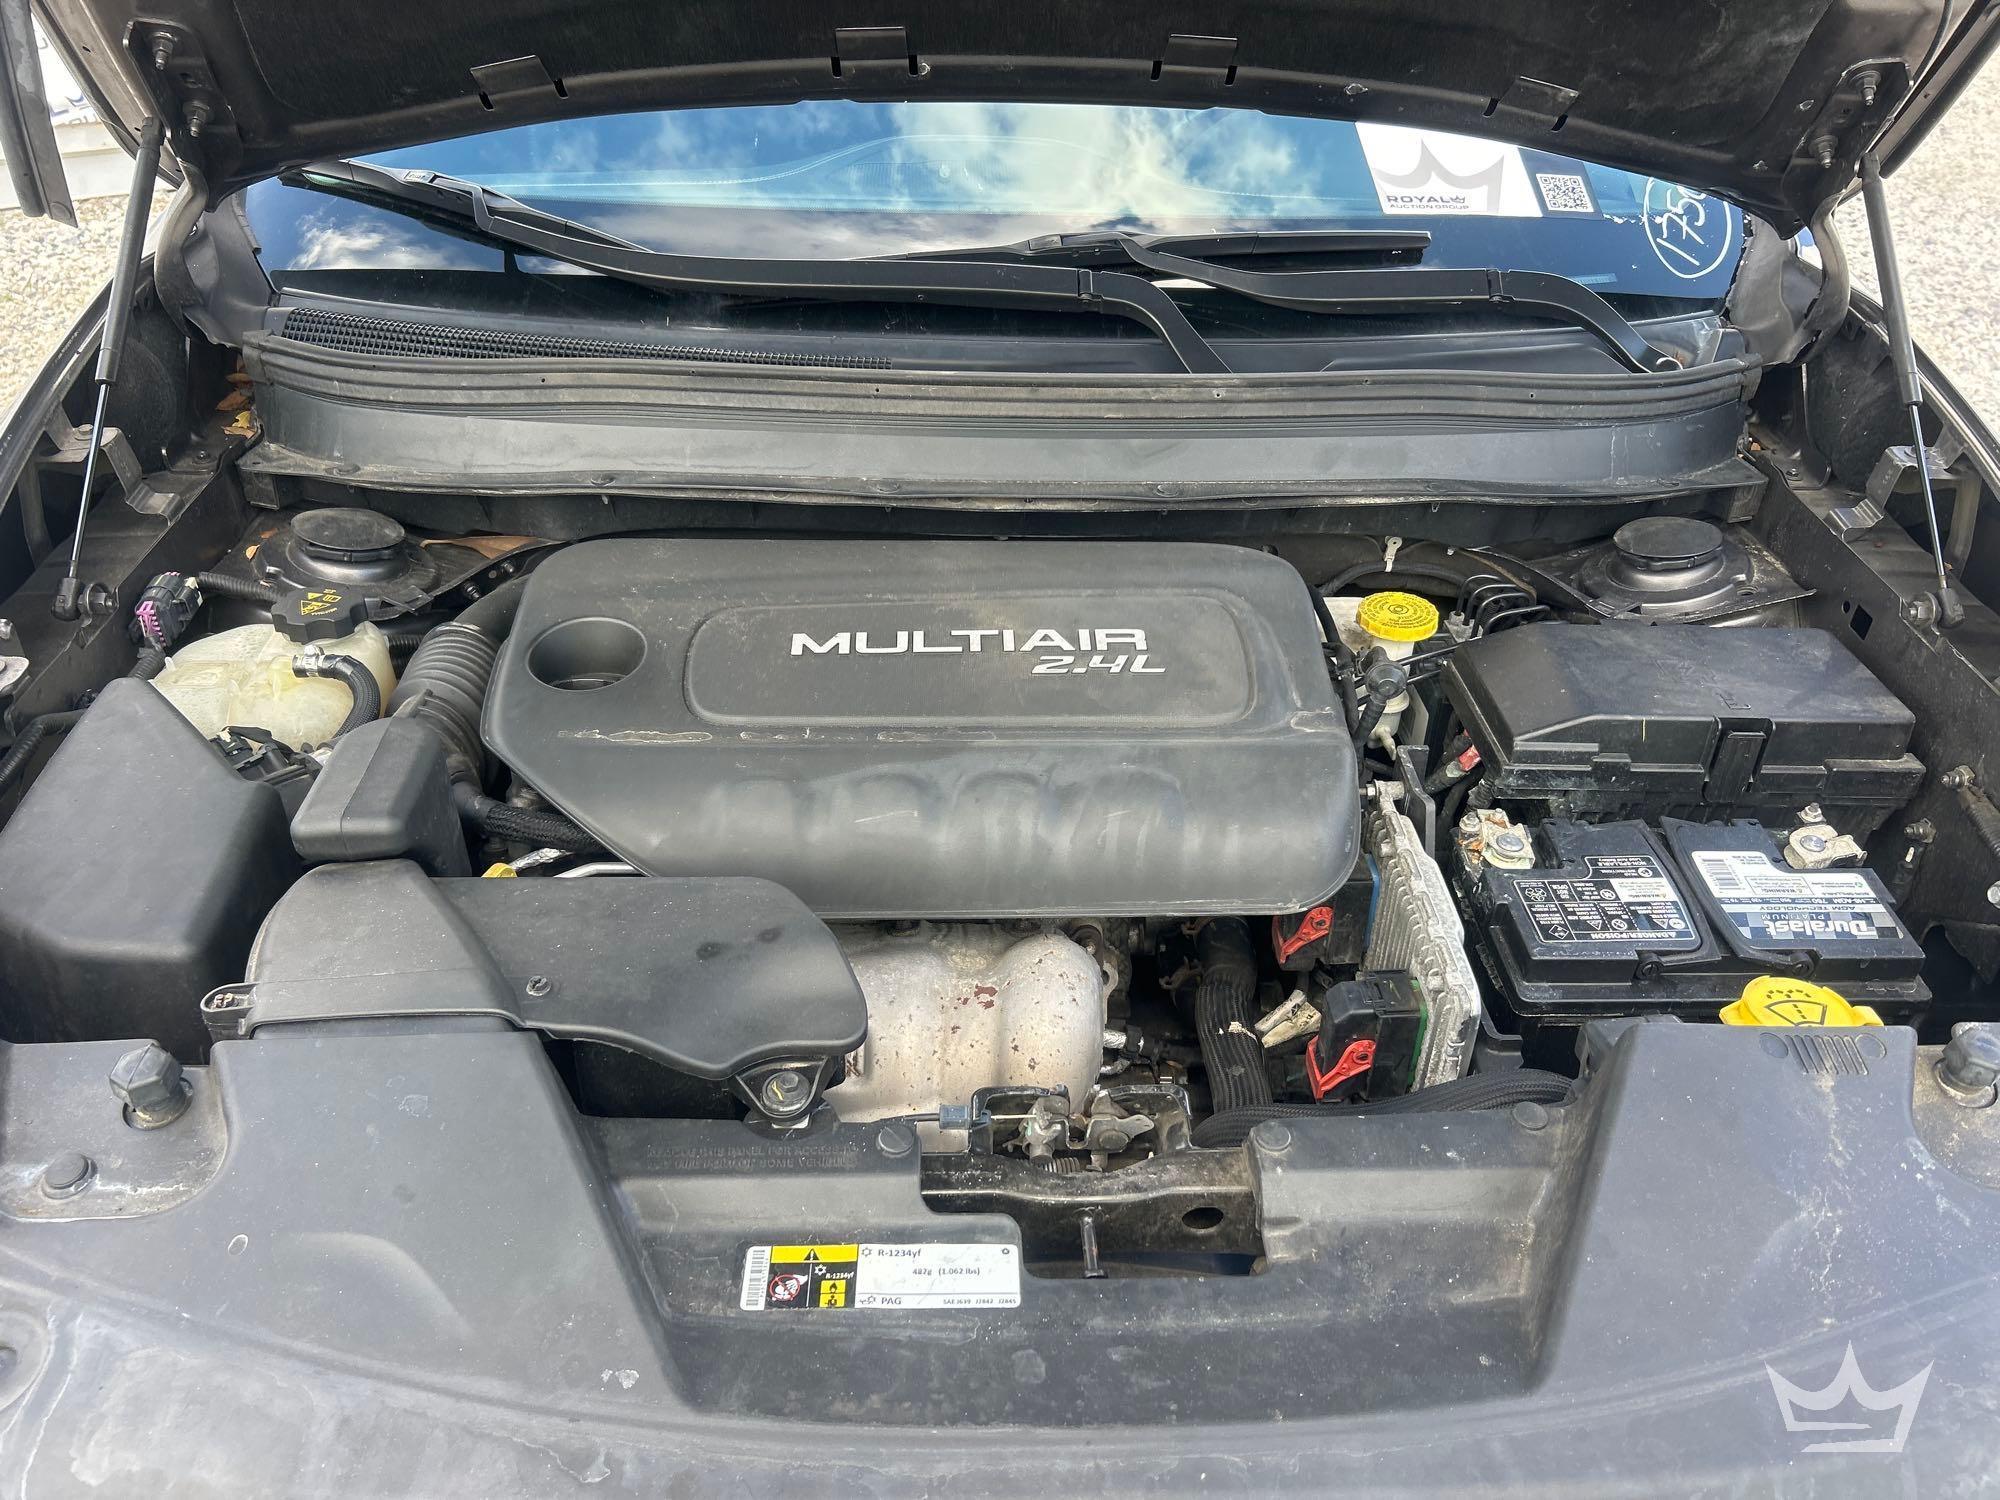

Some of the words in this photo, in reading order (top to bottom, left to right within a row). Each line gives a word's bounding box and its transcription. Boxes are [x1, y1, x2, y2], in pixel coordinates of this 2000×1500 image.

[1386, 195, 1451, 204] ROYAL
[790, 628, 1149, 657] MULTIAIR
[1031, 654, 1167, 675] 2.4L
[1765, 919, 1876, 936] Duralast
[877, 1248, 922, 1258] R-1234yf
[825, 1271, 855, 1280] R-1234yf
[938, 1267, 965, 1276] (1.062
[965, 1267, 981, 1276] lbs)
[881, 1297, 902, 1305] PAG
